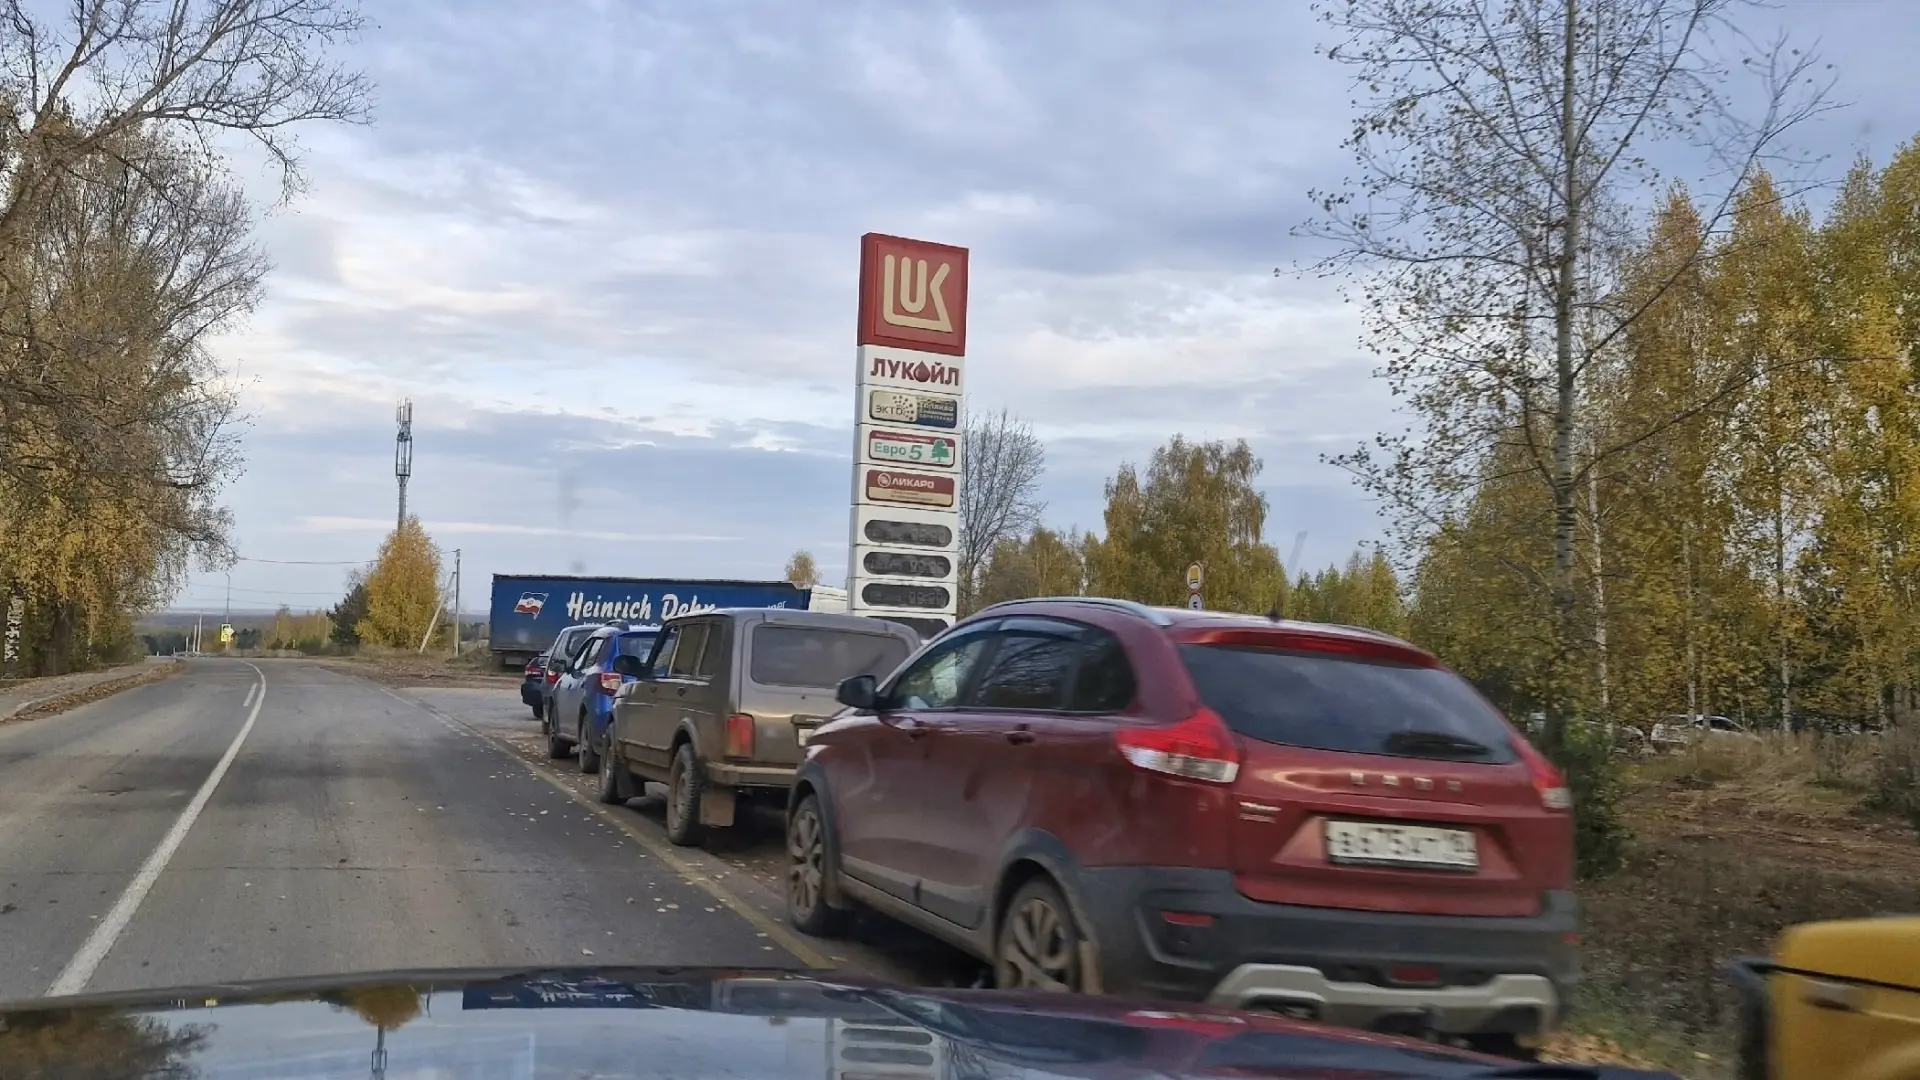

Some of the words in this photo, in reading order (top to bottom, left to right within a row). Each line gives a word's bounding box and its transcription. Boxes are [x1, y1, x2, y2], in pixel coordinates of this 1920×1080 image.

[870, 358, 959, 386] ЛУКОЙЛ
[874, 442, 906, 456] Евро
[909, 444, 923, 460] 5
[566, 591, 652, 621] Heinrich
